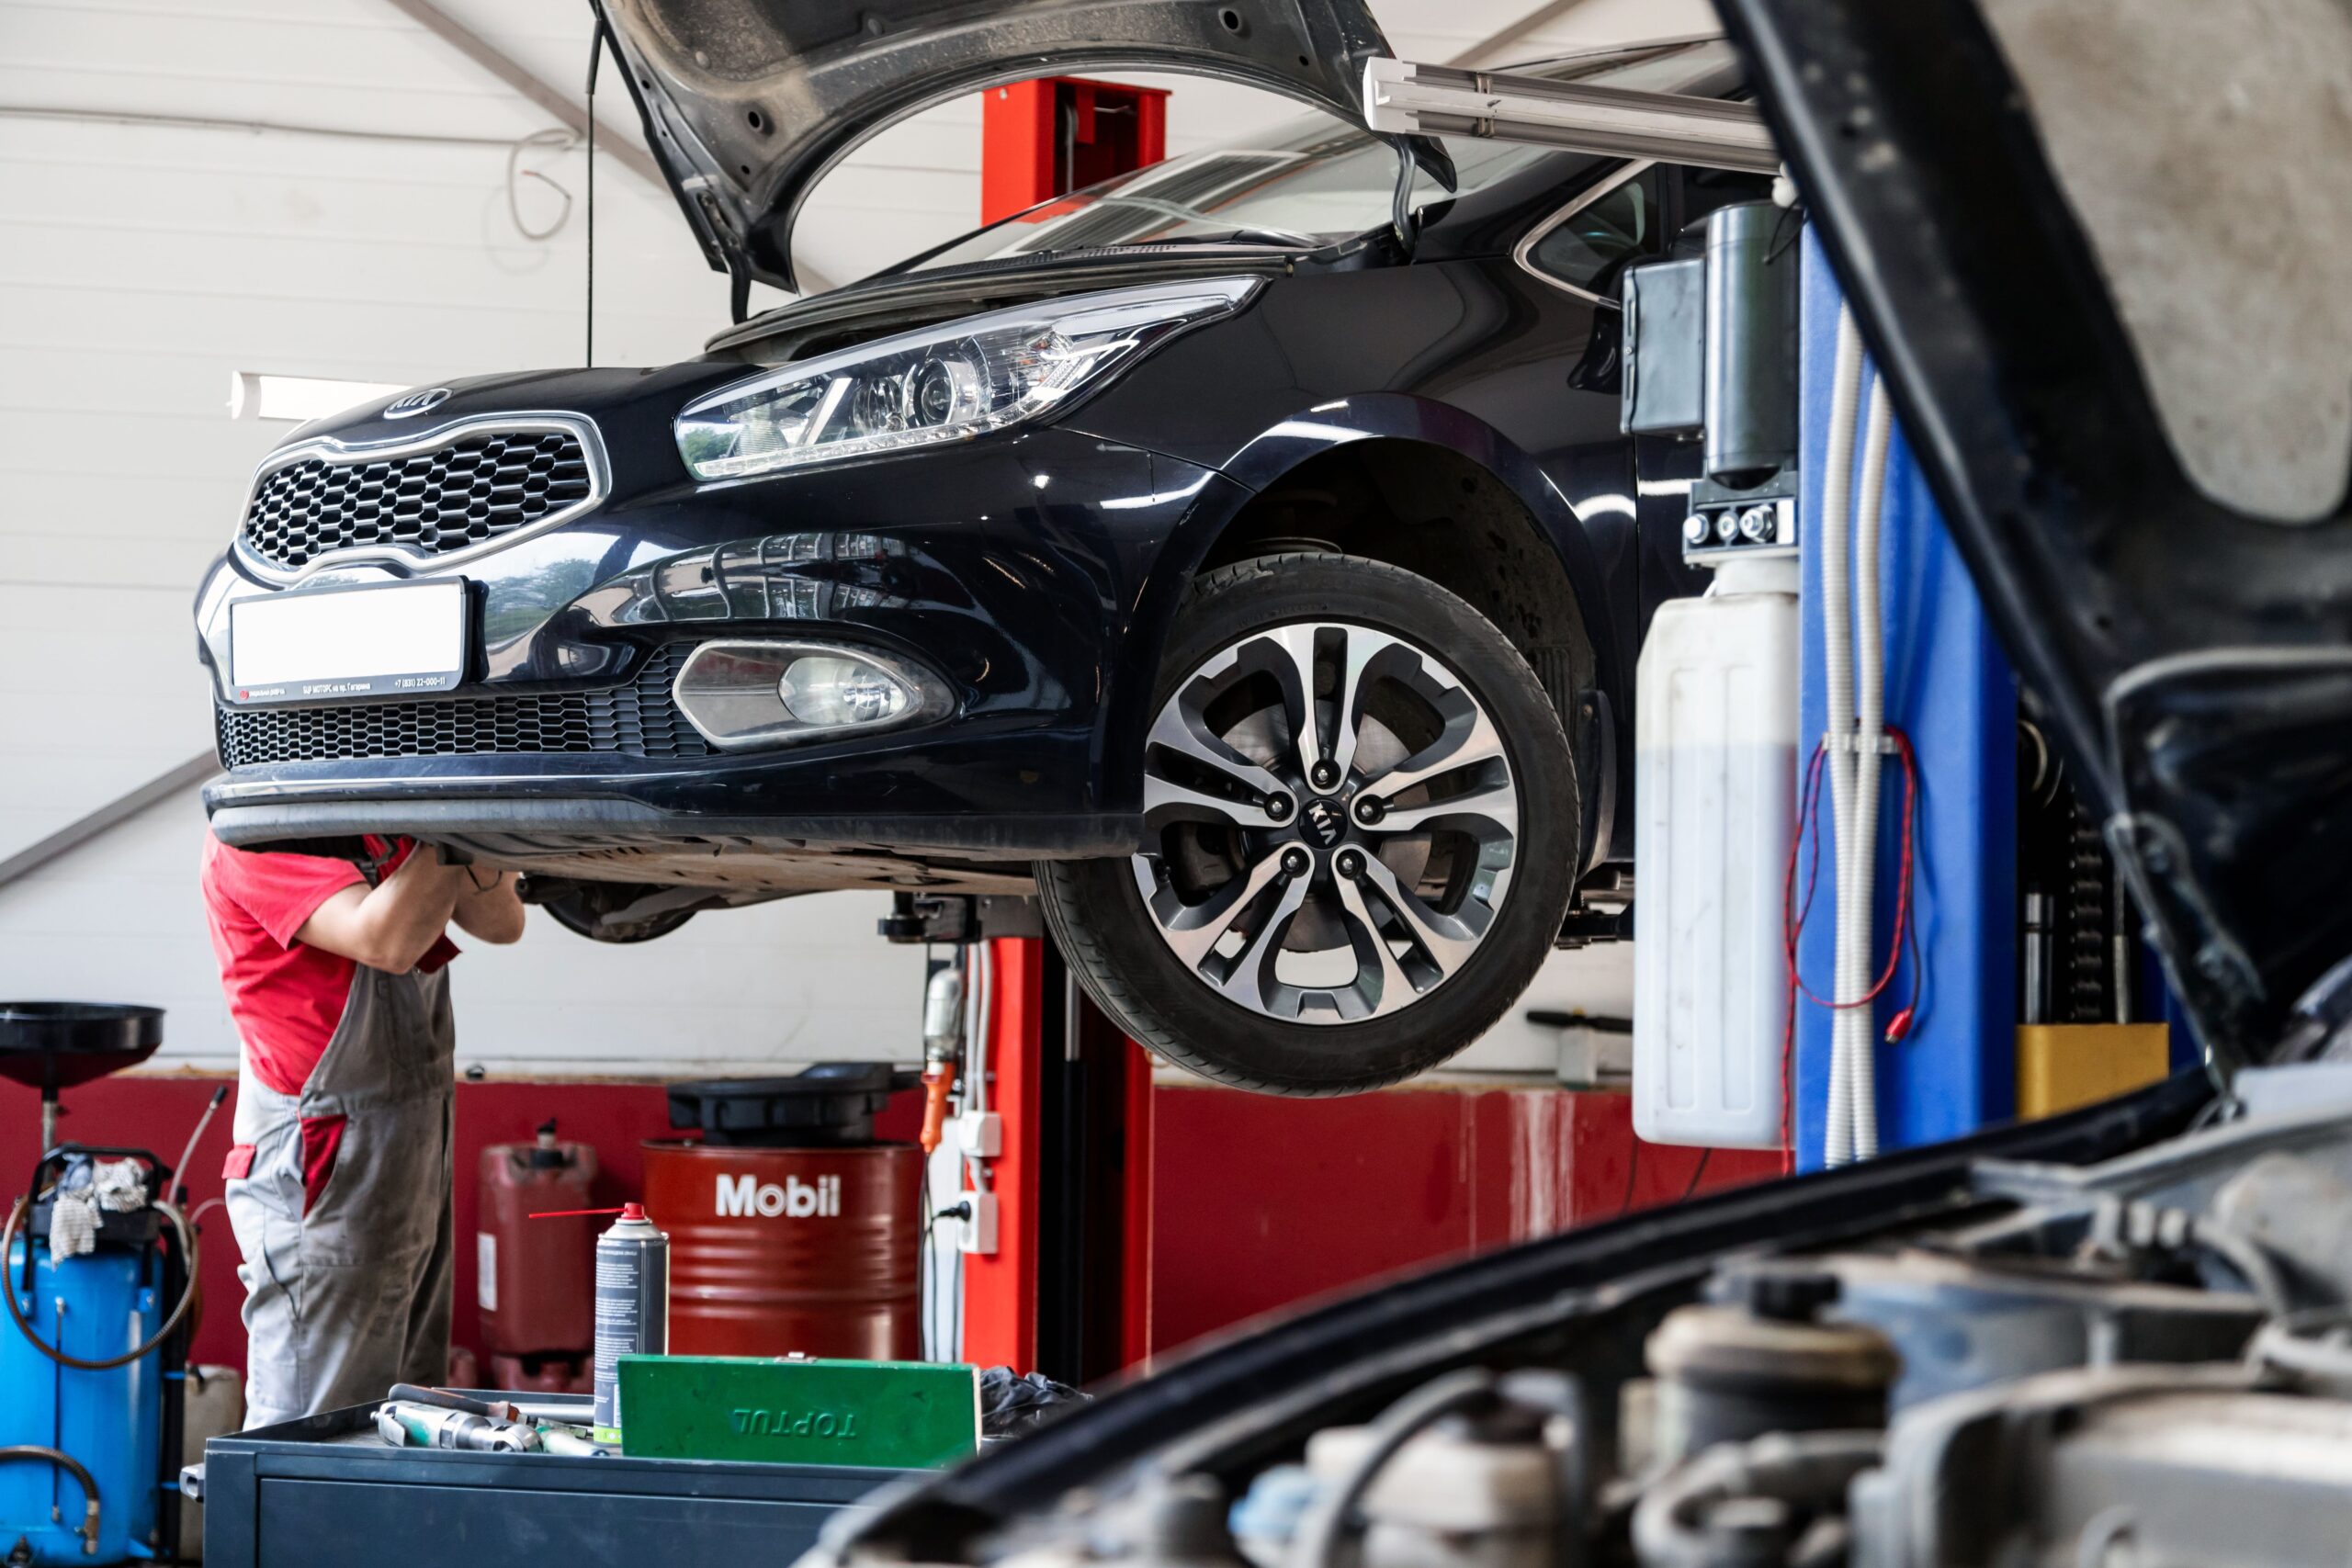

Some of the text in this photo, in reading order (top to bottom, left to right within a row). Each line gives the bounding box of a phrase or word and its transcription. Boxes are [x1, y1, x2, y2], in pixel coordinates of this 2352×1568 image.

[1308, 803, 1337, 845] KIA
[716, 1173, 841, 1218] Mobil
[734, 1408, 857, 1439] TOPTUL
